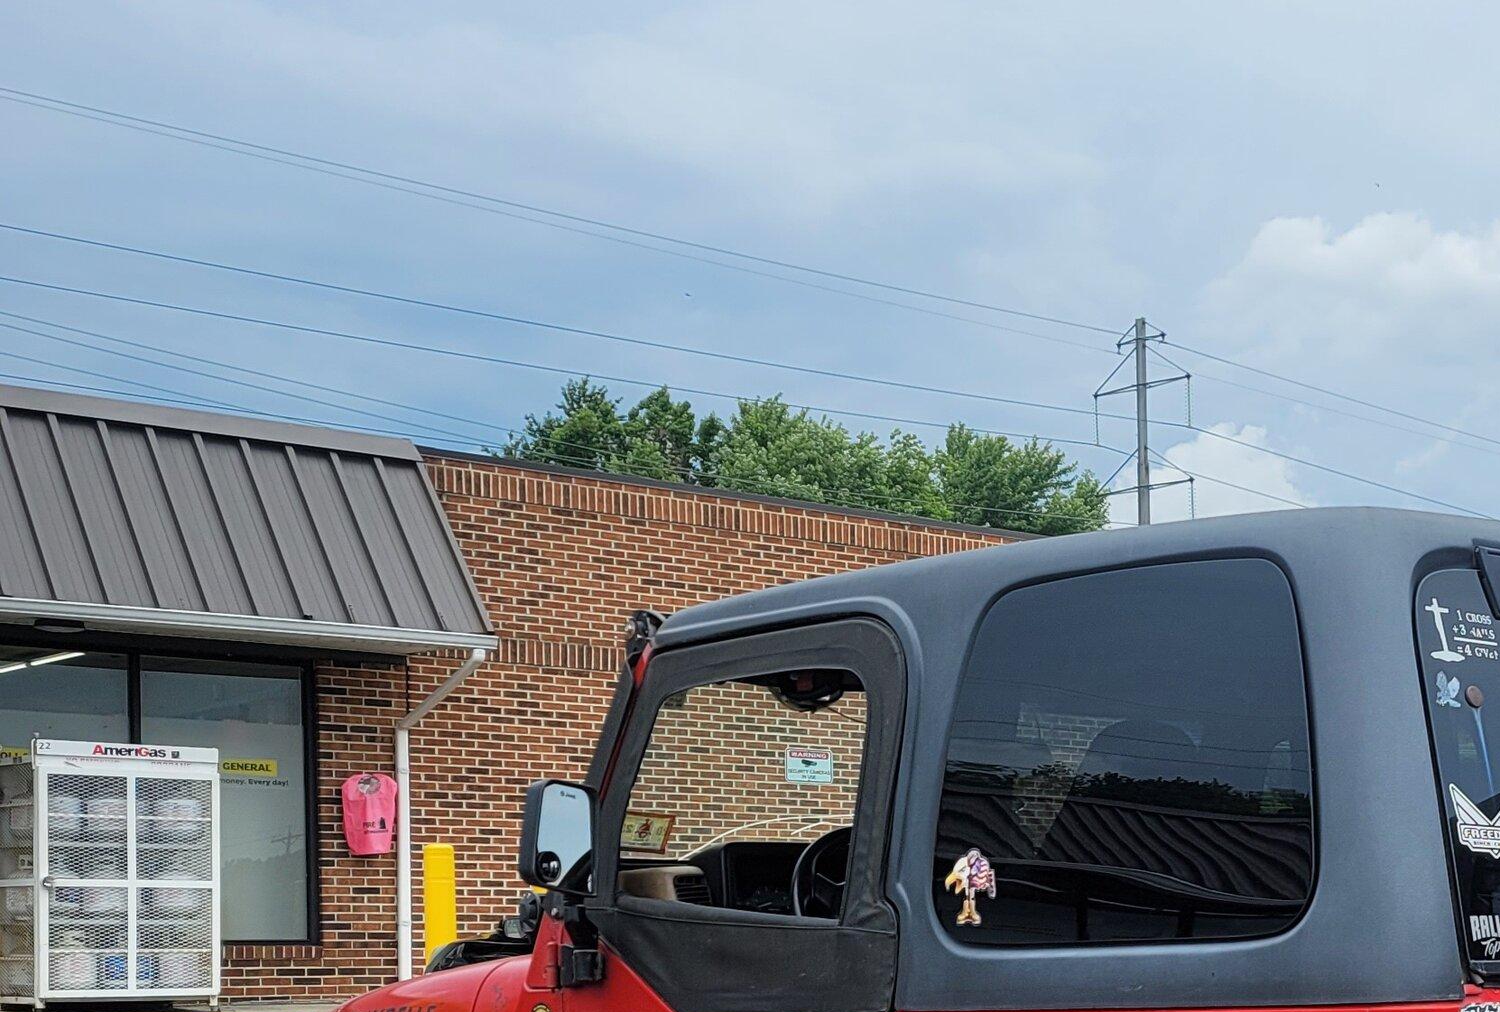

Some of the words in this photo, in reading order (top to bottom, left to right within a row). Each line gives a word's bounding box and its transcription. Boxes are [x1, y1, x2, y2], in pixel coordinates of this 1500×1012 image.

[1465, 612, 1492, 625] CROSS
[38, 742, 51, 750] 22
[92, 744, 167, 758] AmeriGas
[791, 751, 827, 759] WARNING
[222, 761, 272, 773] GENERAL
[248, 778, 271, 787] Every
[272, 780, 289, 788] day!
